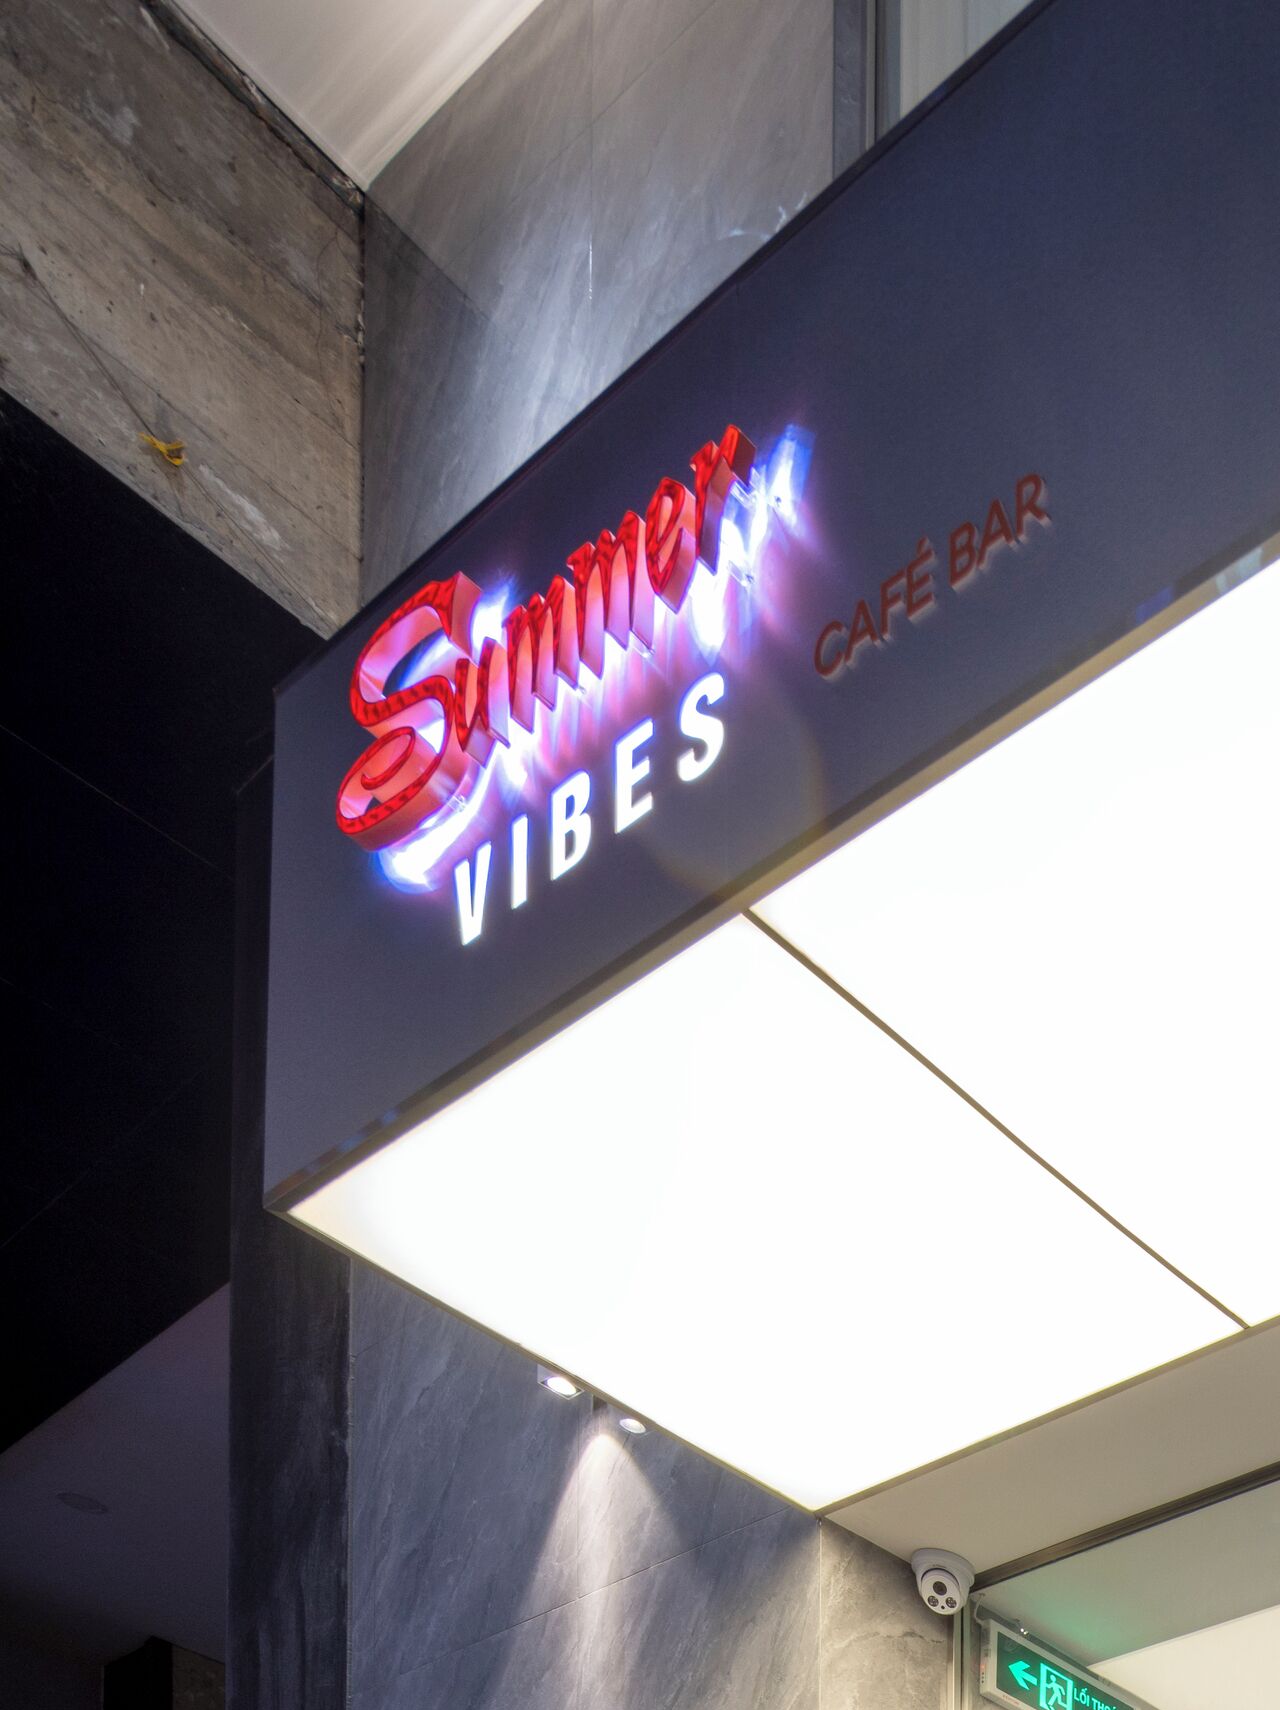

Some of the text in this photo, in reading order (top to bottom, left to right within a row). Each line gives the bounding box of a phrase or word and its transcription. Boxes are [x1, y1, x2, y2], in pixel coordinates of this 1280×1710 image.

[336, 424, 756, 852] Summer
[813, 473, 1050, 678] CAFÉ BAR
[453, 672, 725, 946] VIBES
[1073, 1687, 1090, 1707] LỐI
